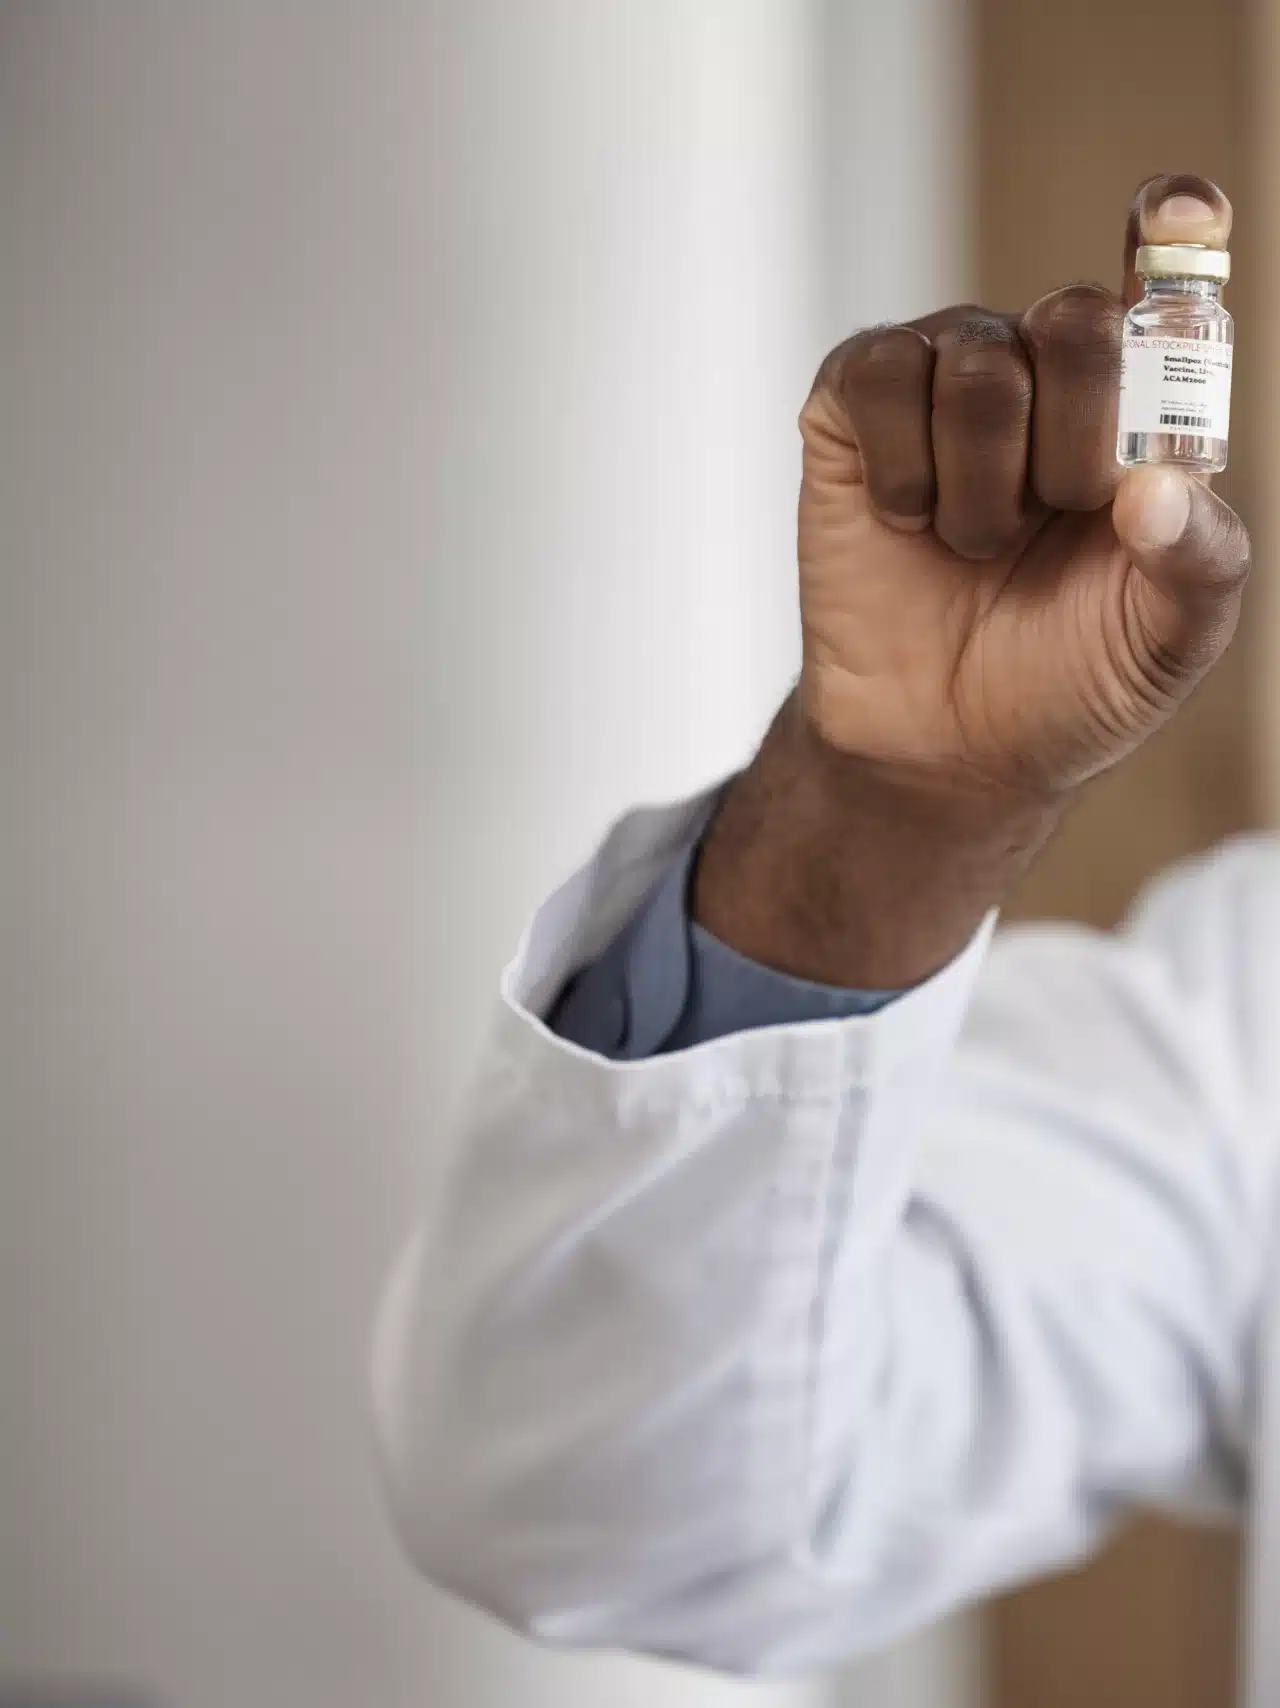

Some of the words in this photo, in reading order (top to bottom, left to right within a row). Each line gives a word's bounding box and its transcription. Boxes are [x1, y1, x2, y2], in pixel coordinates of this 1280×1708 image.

[1164, 356, 1201, 364] Smallpox
[1163, 365, 1197, 374] Vaccine,
[1163, 375, 1206, 384] ACAM2000
